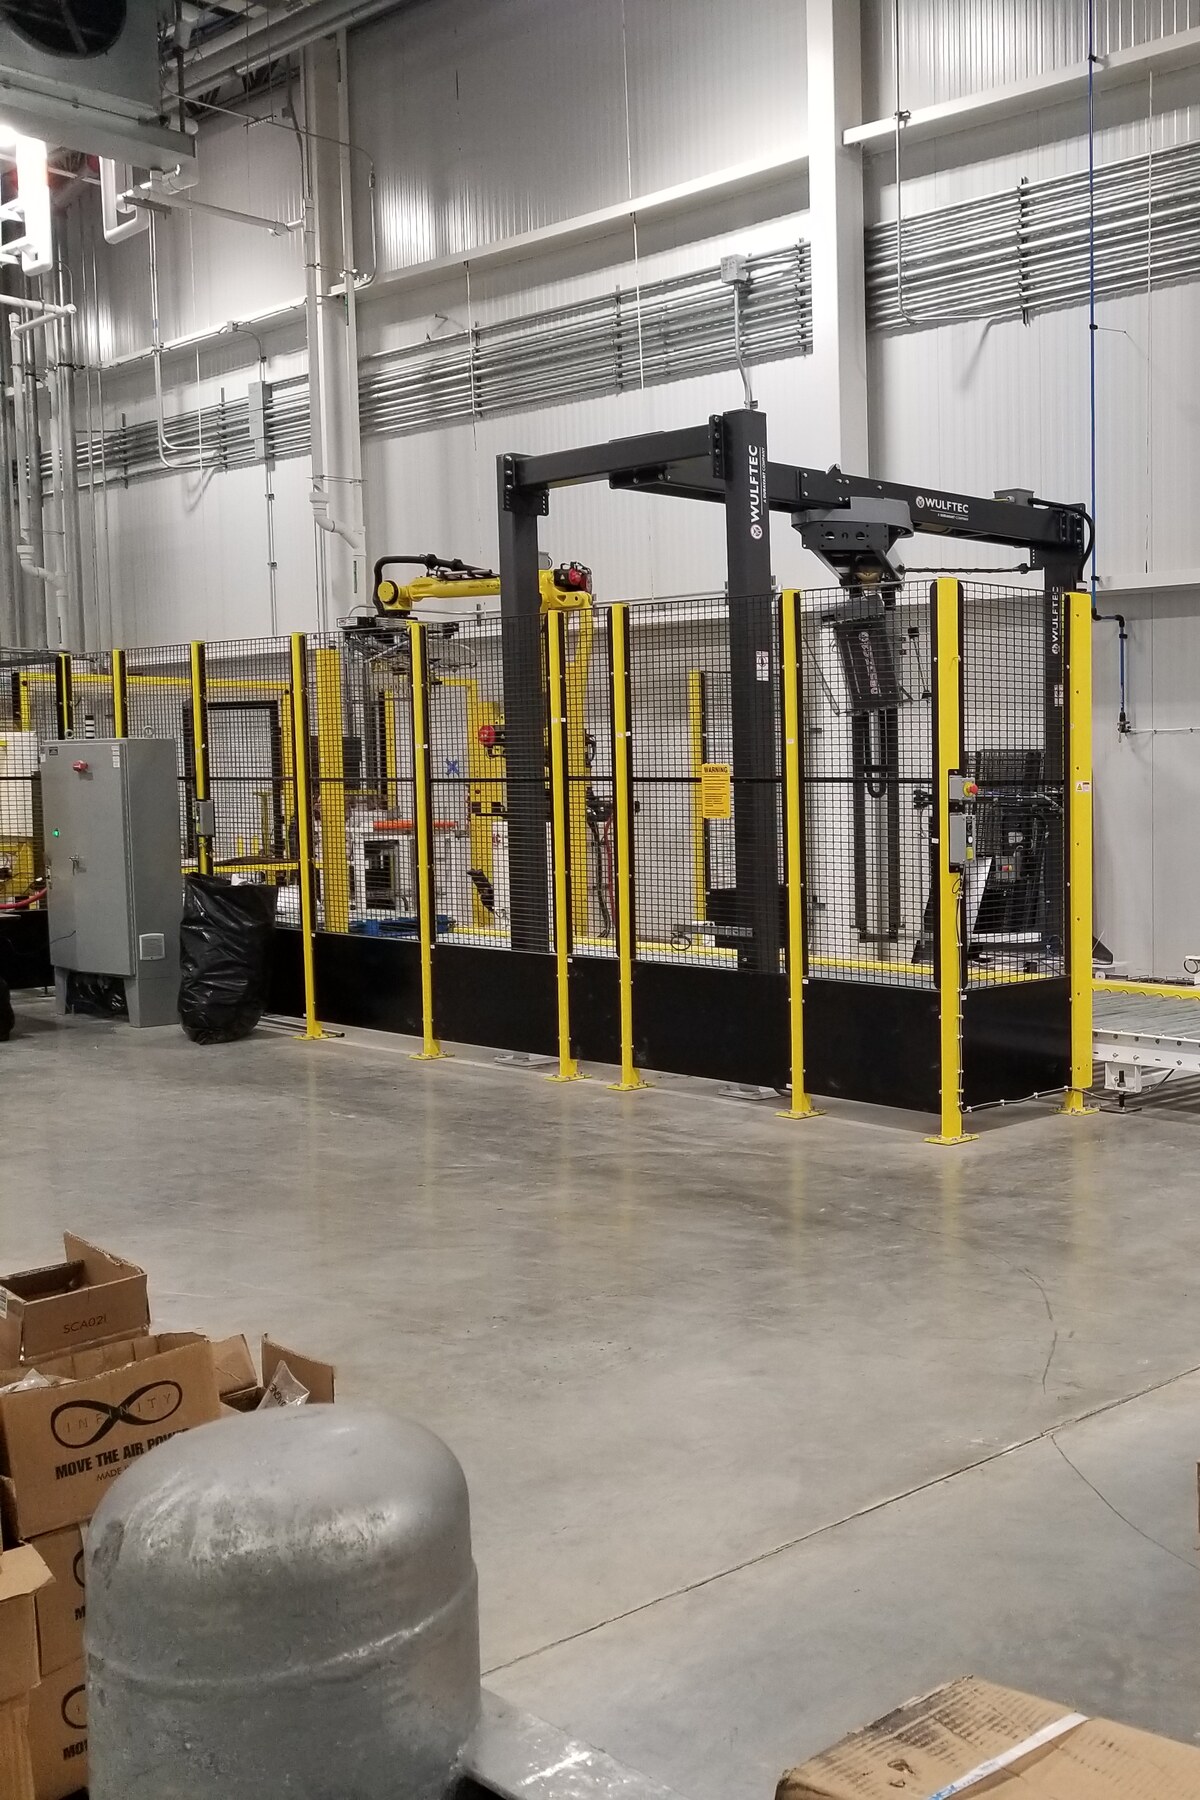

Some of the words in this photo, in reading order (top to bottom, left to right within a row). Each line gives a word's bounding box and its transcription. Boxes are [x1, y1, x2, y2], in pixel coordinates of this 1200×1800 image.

[748, 445, 761, 523] WULFTEC
[925, 498, 969, 513] WULFTEC
[1051, 586, 1060, 643] WULFTEC
[703, 765, 729, 774] WARNING
[66, 1393, 171, 1433] INFINITY
[55, 1456, 93, 1480] MOVE
[95, 1449, 120, 1467] THE
[123, 1442, 145, 1459] AIR
[96, 1466, 122, 1481] MADE
